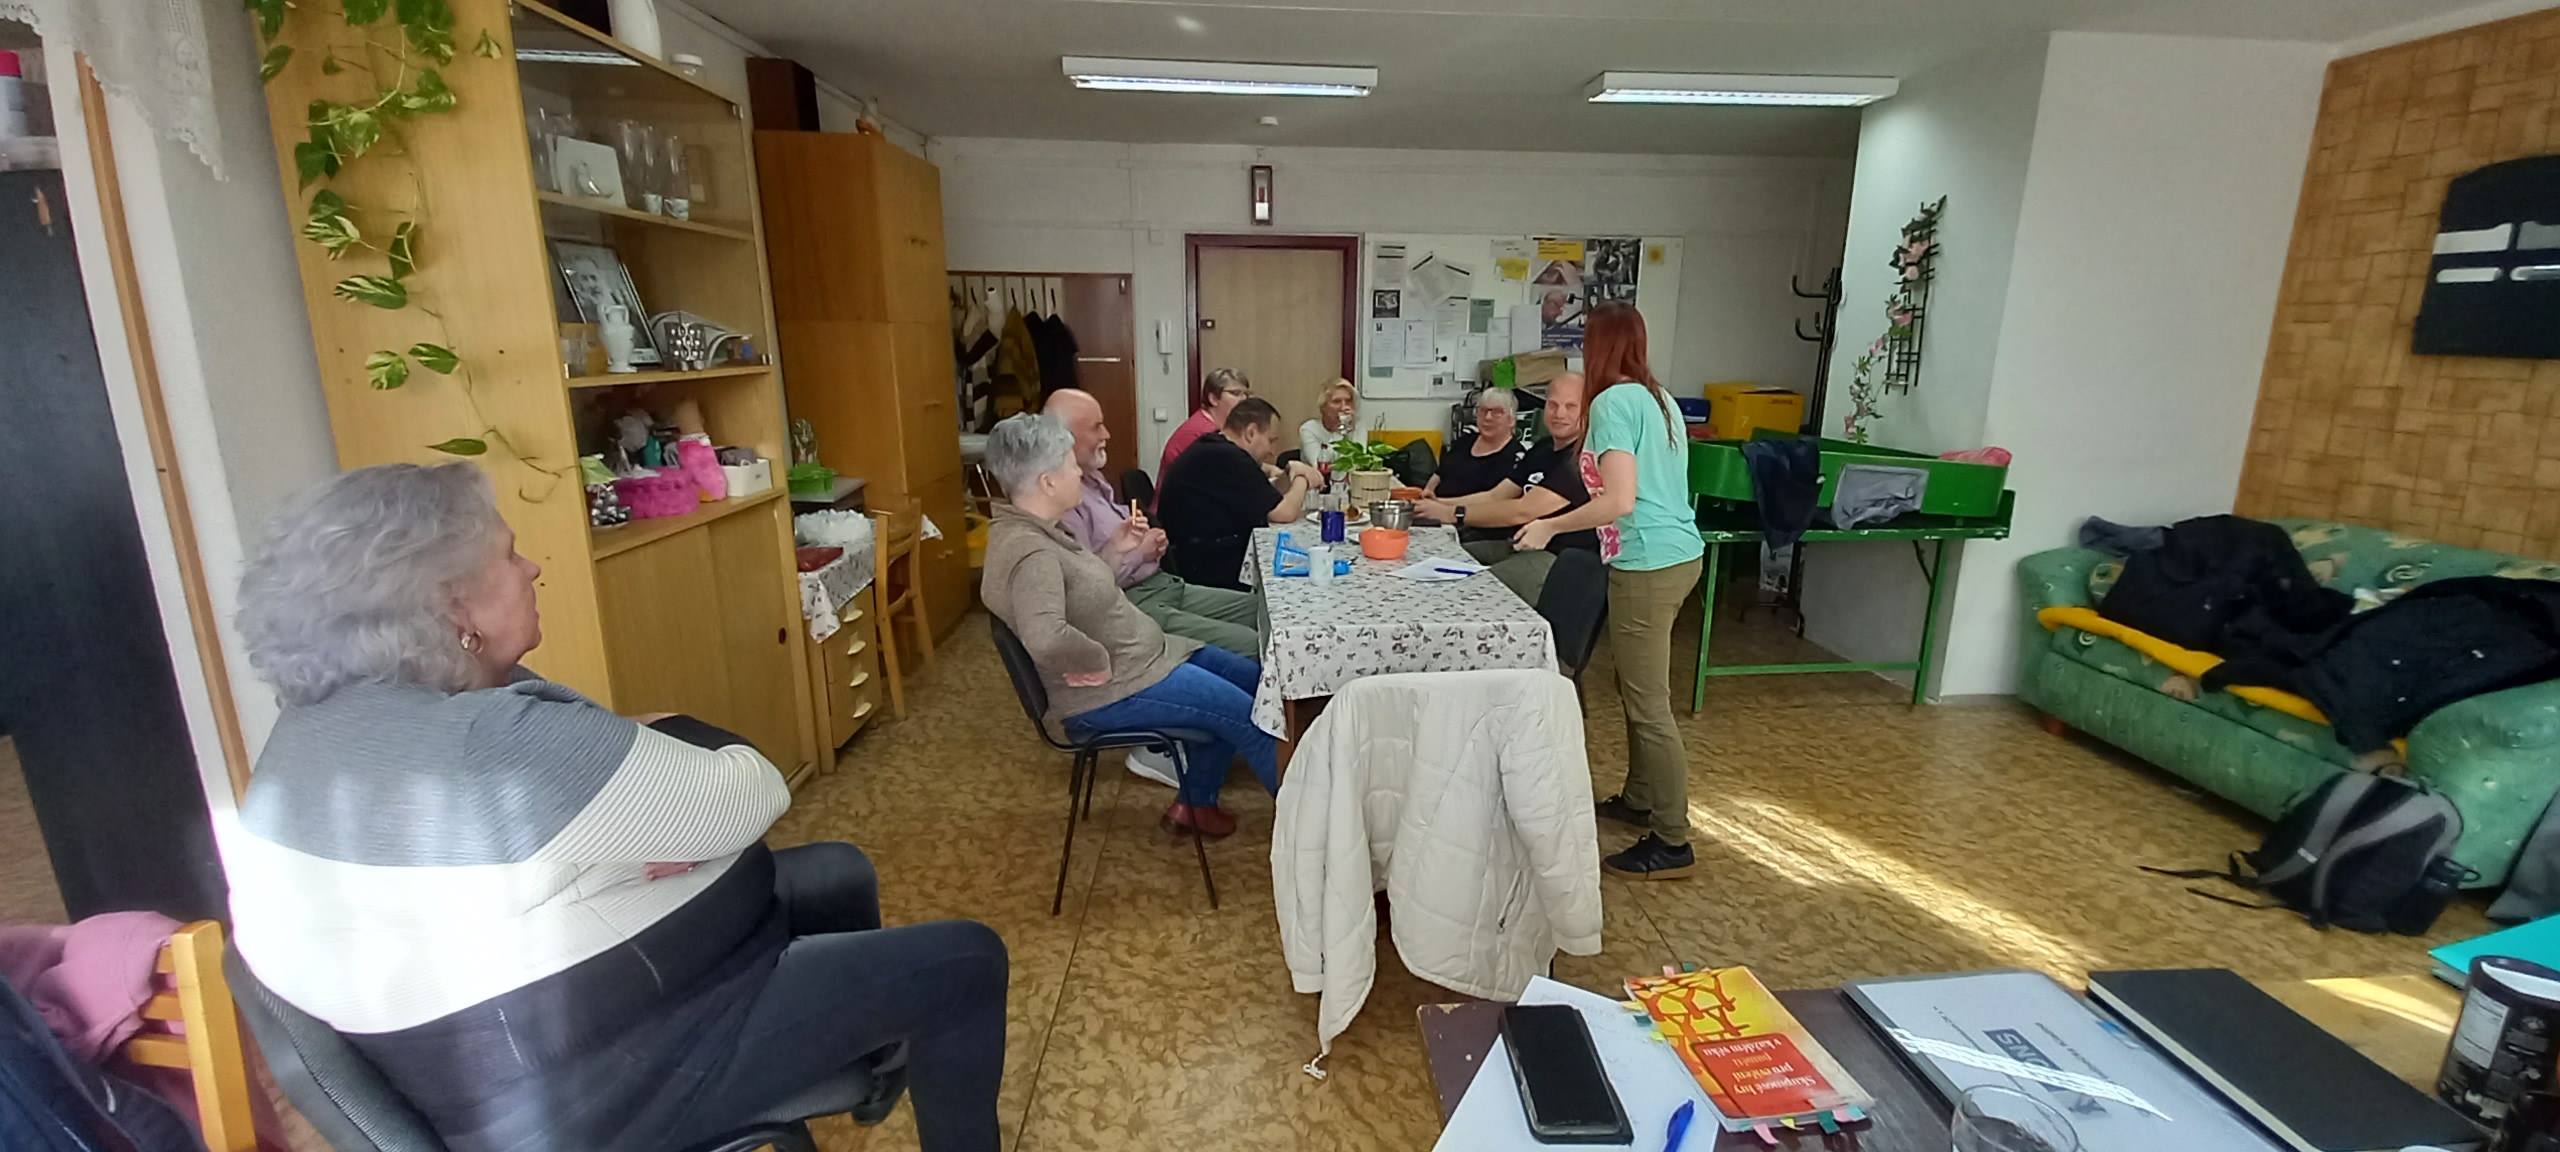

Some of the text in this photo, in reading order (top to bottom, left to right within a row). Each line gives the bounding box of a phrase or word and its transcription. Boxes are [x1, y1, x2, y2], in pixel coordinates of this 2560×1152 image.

[1702, 1038, 1782, 1058] v každém věku
[1771, 1061, 1794, 1073] pro
[1733, 1075, 1817, 1096] Skupinové hry
